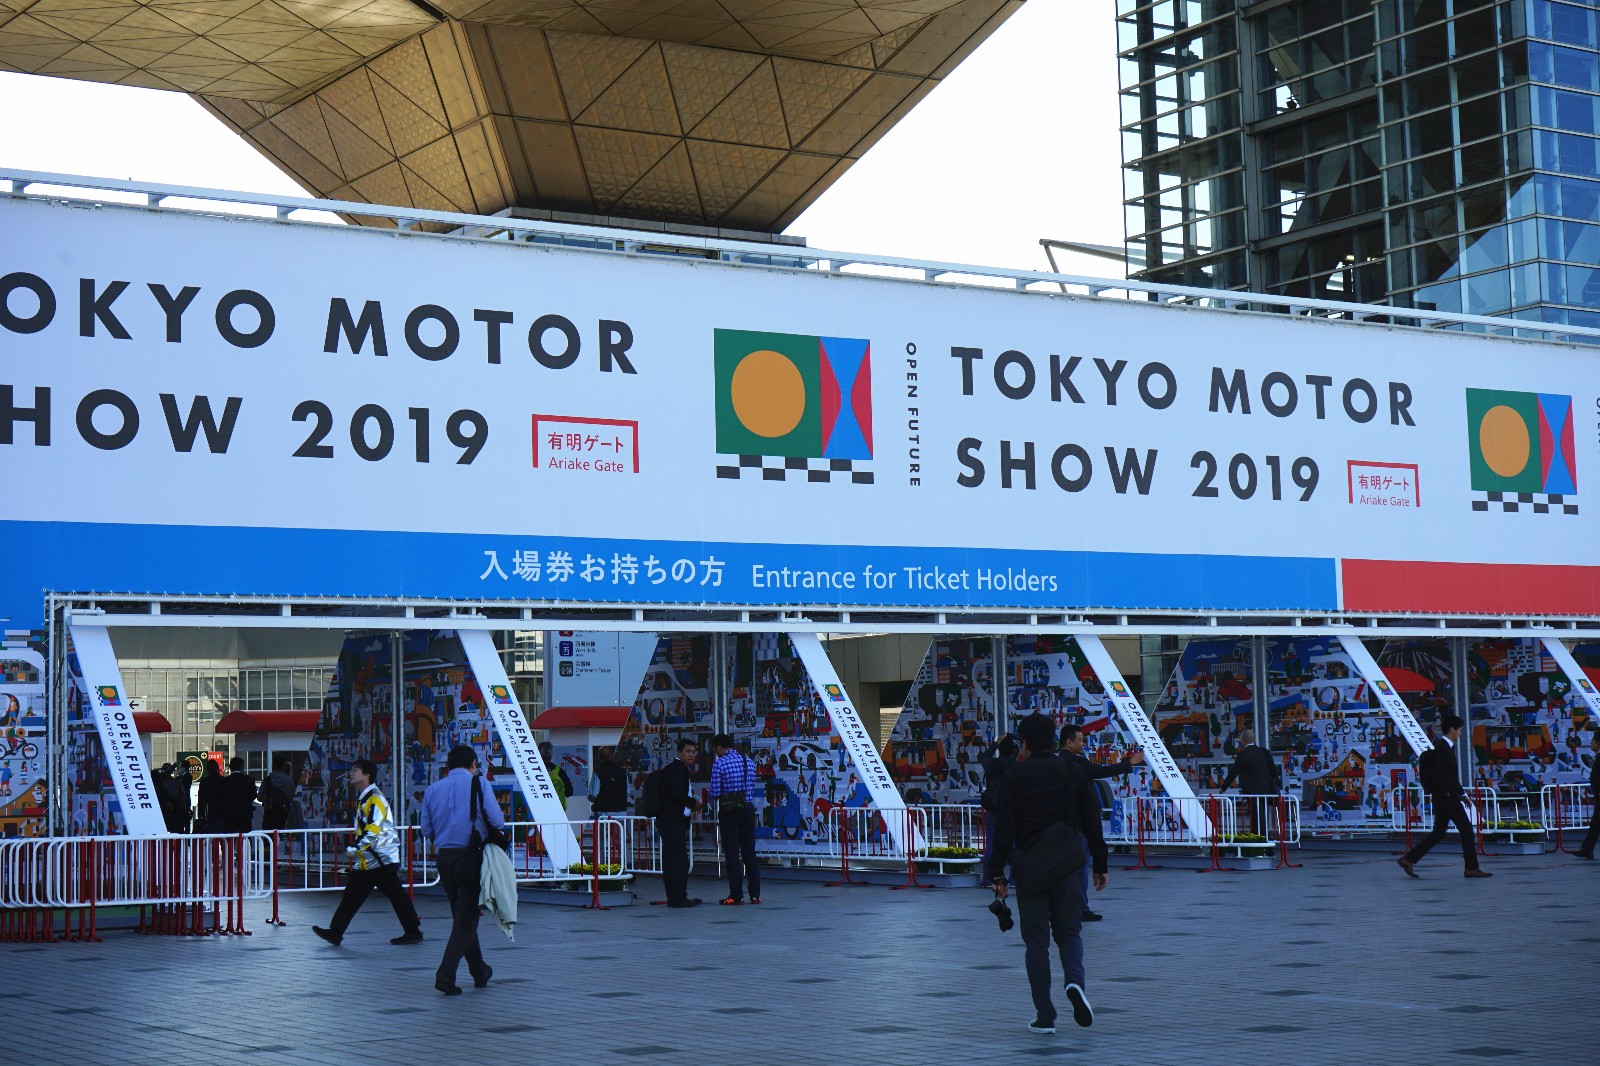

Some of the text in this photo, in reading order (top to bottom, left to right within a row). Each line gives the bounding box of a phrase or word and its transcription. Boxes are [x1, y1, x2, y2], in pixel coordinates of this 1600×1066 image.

[323, 297, 638, 375] MOTOR
[906, 342, 921, 486] OPEN FUTURE
[950, 346, 1416, 426] TOKYO MOTOR
[291, 400, 488, 465] 2019
[548, 432, 624, 453] 有明ゲート
[548, 457, 624, 472] Ariake Gate
[956, 437, 1319, 502] SHOW 2019
[1358, 474, 1409, 491] 有明ゲート
[1360, 495, 1410, 507] Ariake Gate
[479, 550, 726, 587] 入場券お持ちの方
[752, 565, 1058, 592] Entrance for Ticket Holders
[498, 710, 510, 732] TOKYO
[508, 734, 522, 758] MOTOR
[519, 761, 532, 782] SHOW
[1128, 702, 1179, 779] OPEN FUTURE
[1394, 700, 1416, 727] OPEN
[102, 713, 136, 810] TOKYO MOTOR SHOW 2019
[114, 712, 152, 809] OPEN FUTURE
[508, 709, 553, 799] OPEN FUTURE
[843, 707, 891, 789] OPEN FUTURE
